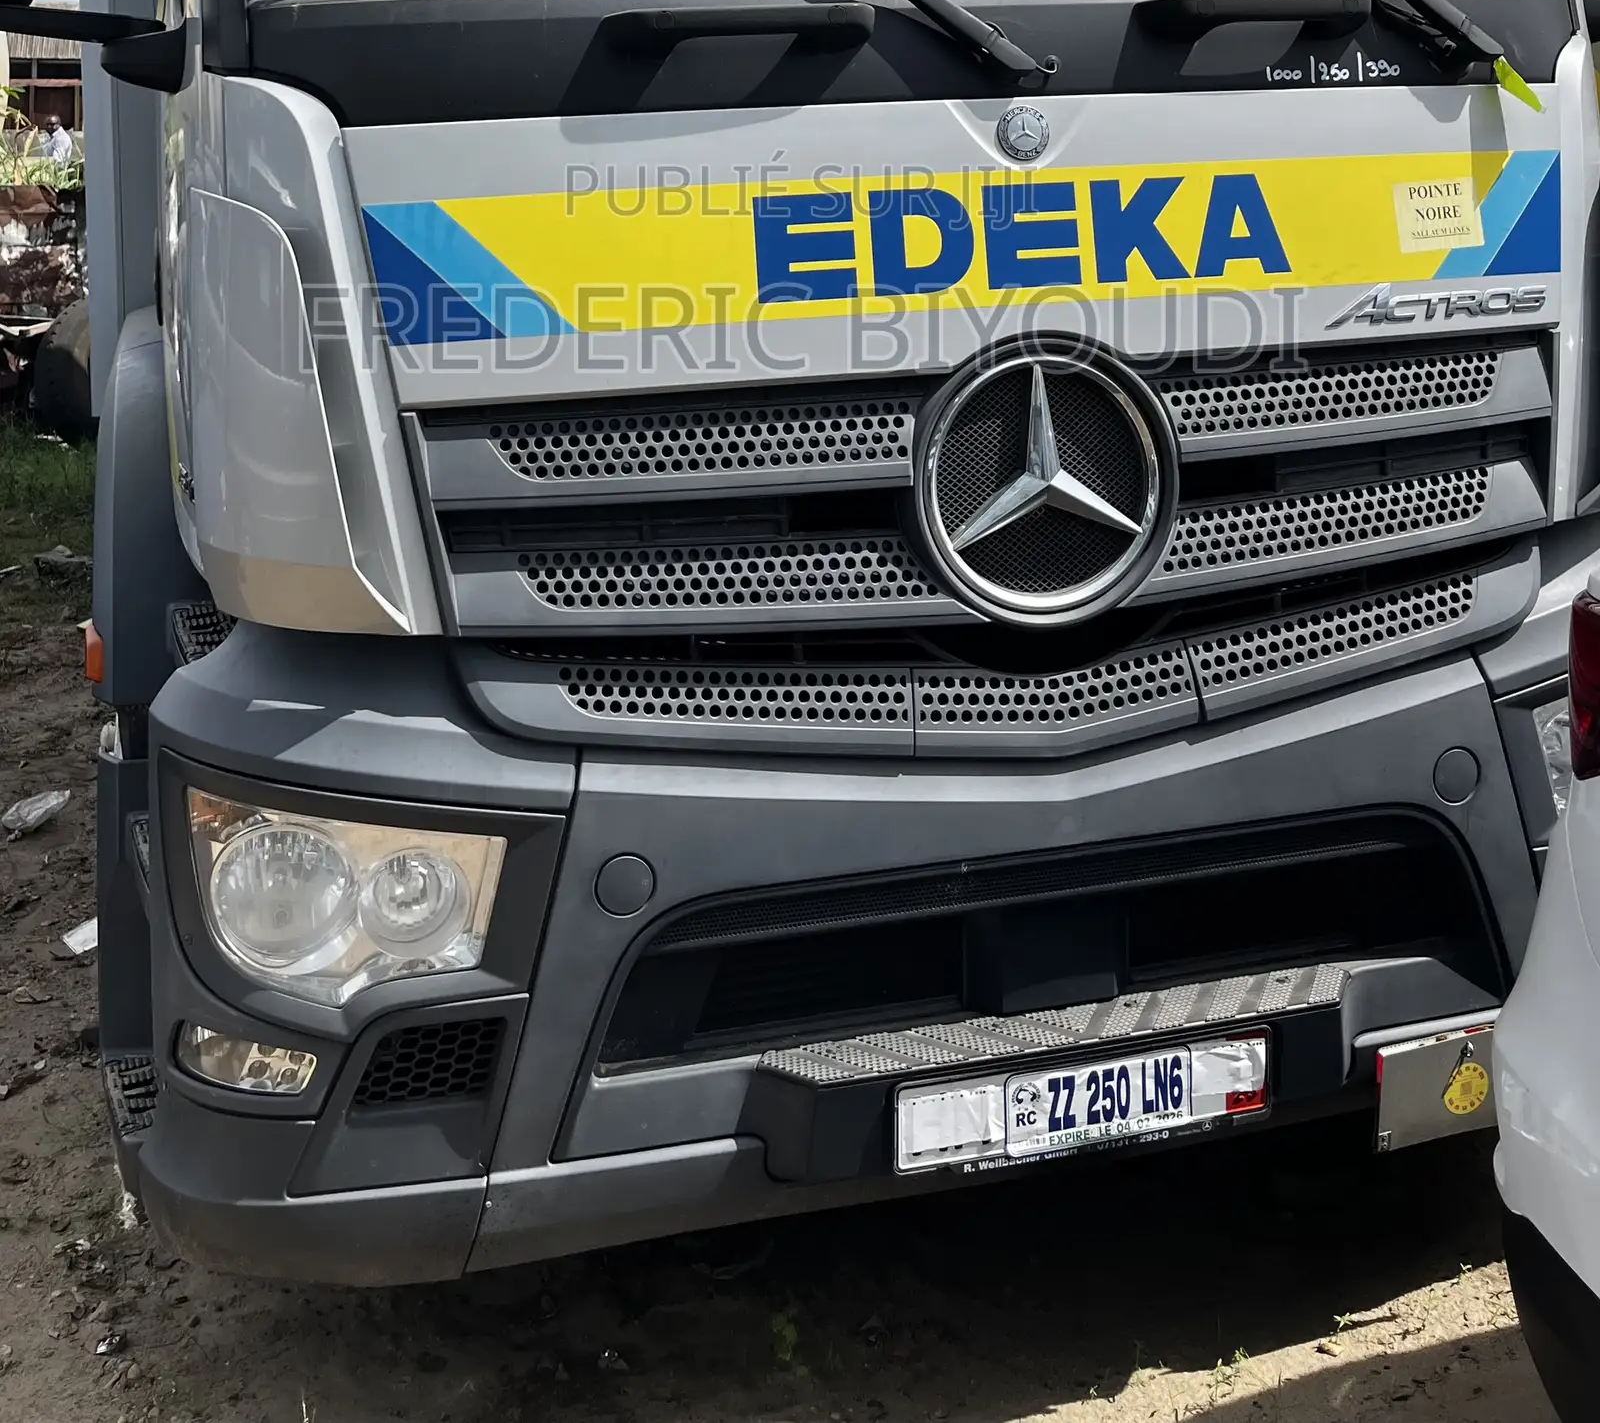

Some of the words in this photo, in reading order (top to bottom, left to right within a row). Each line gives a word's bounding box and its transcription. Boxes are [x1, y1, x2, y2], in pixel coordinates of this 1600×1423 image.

[1017, 149, 1038, 158] BENZ
[1408, 182, 1463, 200] POINTE
[1415, 204, 1462, 222] NOIRE
[752, 172, 1293, 305] EDEKA
[1324, 282, 1547, 330] ACTROS
[1048, 1075, 1077, 1133] ZZ
[1086, 1064, 1131, 1126] 250
[1141, 1054, 1184, 1115] LN6
[1016, 1110, 1037, 1128] RC
[1100, 1124, 1112, 1139] LE
[963, 1163, 975, 1173] R.
